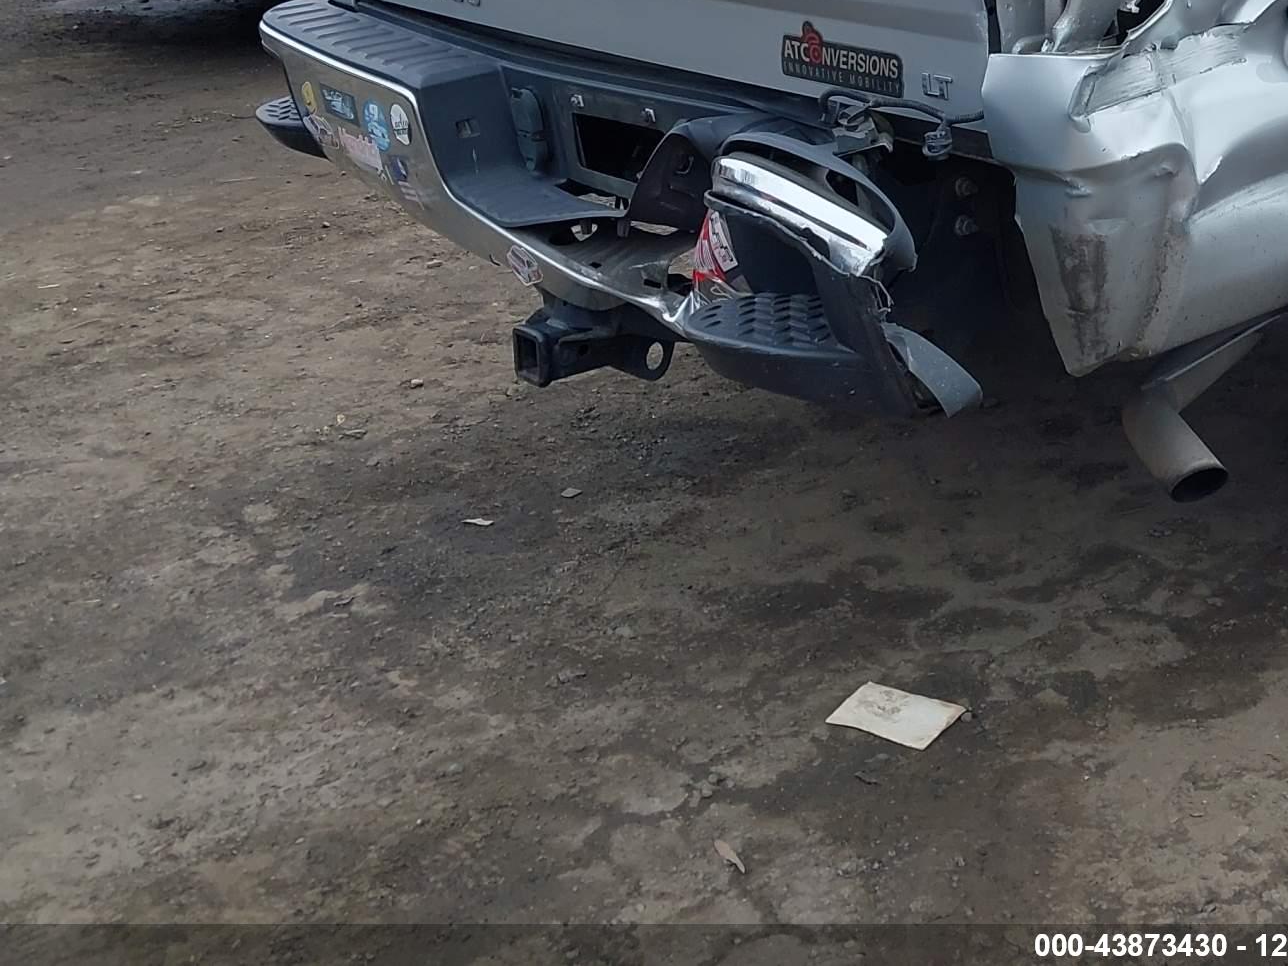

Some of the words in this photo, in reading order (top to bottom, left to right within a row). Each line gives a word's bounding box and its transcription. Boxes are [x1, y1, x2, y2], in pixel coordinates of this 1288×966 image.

[783, 61, 844, 83] INNOVATIVE
[849, 74, 900, 94] MOBILITY
[921, 72, 953, 101] LT
